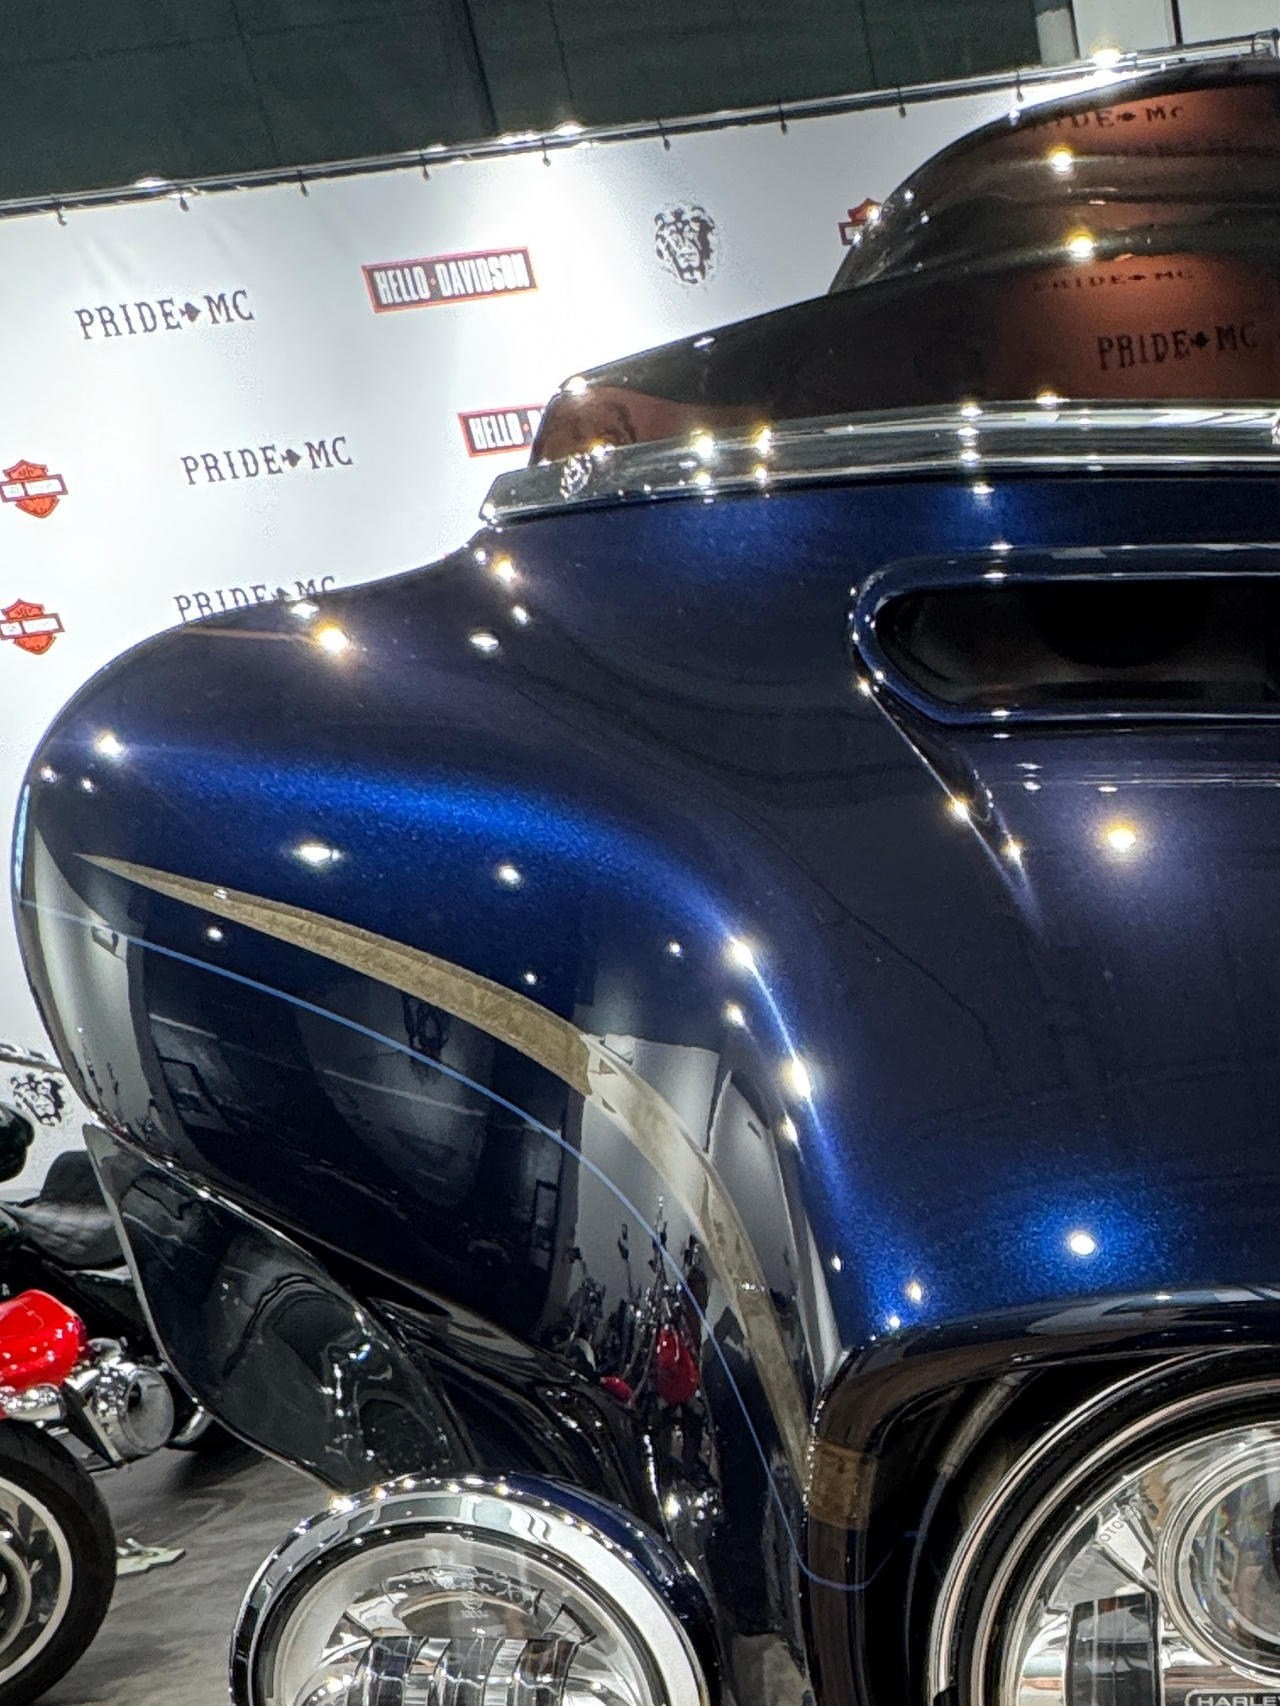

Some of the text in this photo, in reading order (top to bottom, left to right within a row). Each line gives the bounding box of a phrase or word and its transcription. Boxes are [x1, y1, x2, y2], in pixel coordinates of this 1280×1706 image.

[74, 289, 255, 340] PRIDE MC
[1097, 322, 1258, 371] PRIDE MC
[180, 436, 353, 485] PRIDE MC
